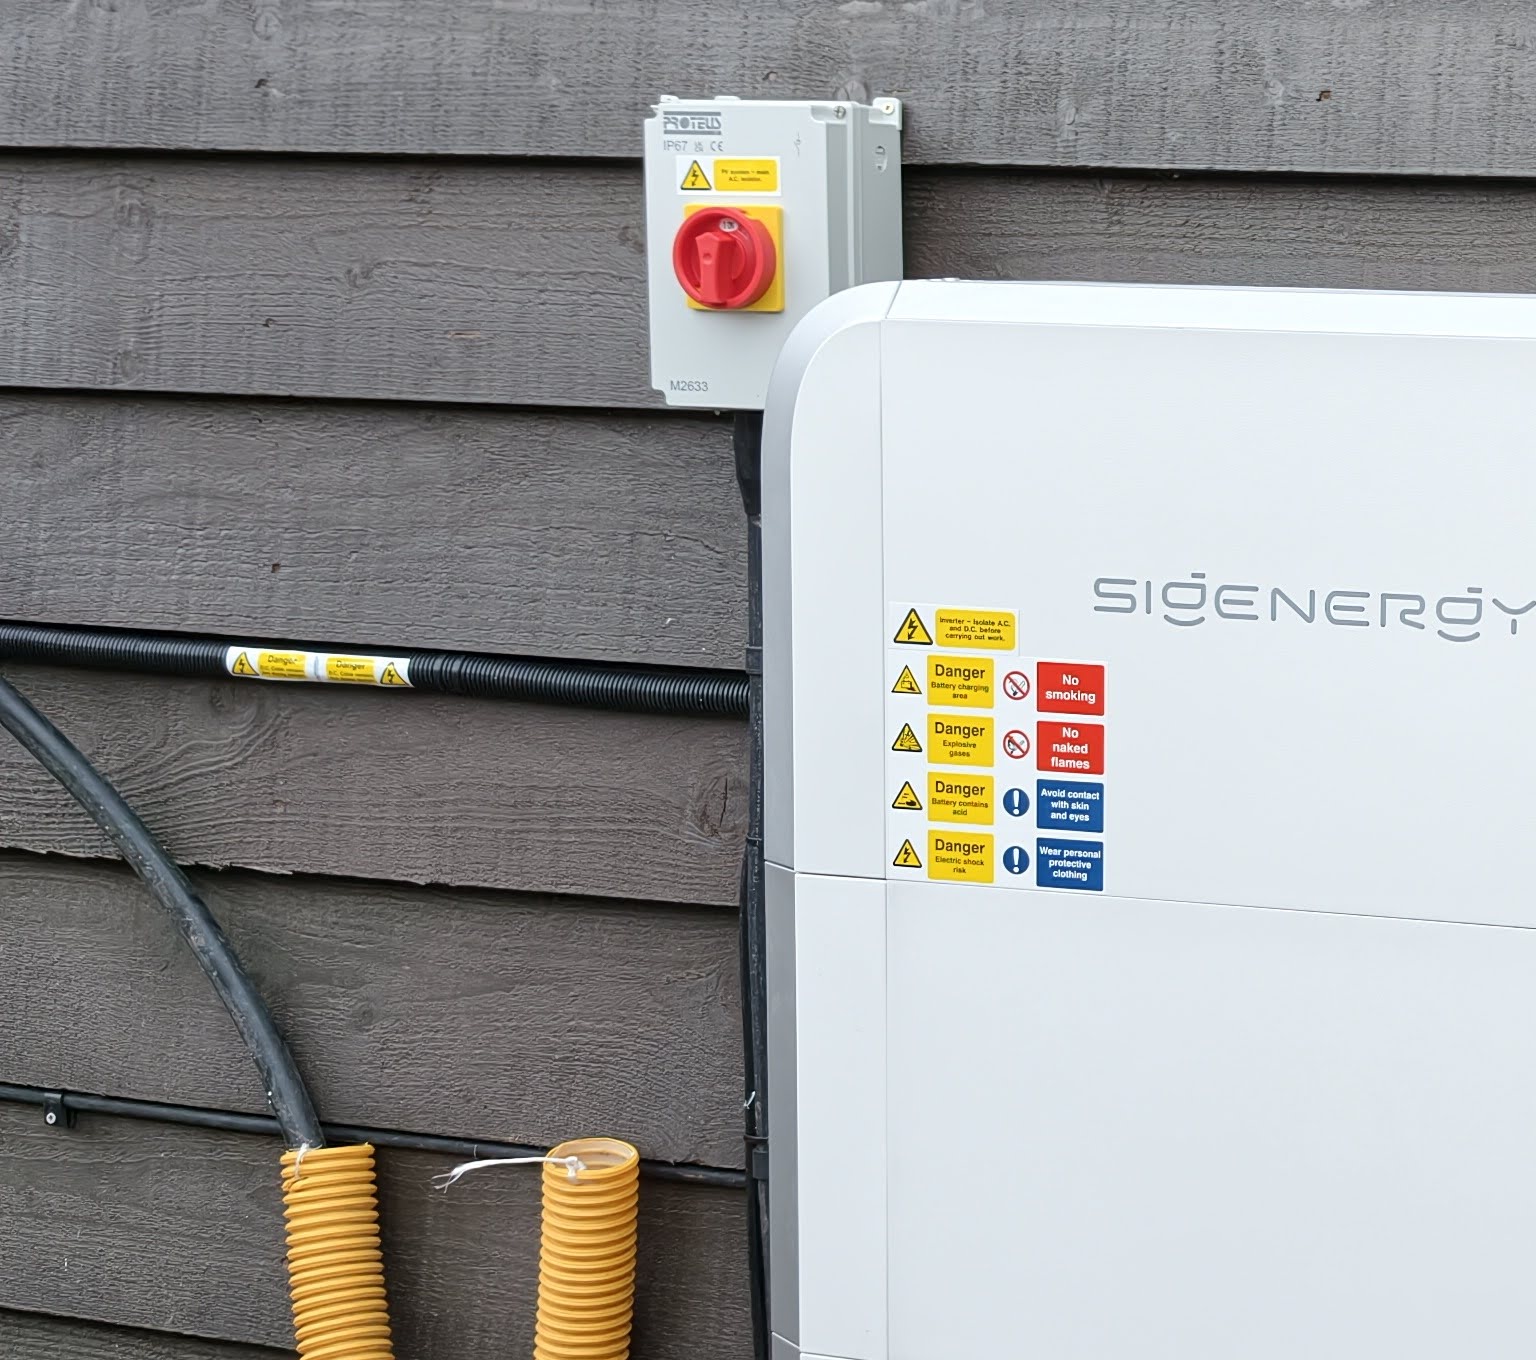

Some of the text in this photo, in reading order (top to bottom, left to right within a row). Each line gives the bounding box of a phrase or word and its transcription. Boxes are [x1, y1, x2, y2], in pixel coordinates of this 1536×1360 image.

[662, 116, 722, 130] PROTEUS
[663, 140, 688, 151] IP67
[670, 380, 709, 391] M2633
[939, 616, 965, 625] Inverter
[945, 633, 972, 641] carrying
[335, 660, 366, 671] Danger
[935, 664, 985, 681] Danger
[1062, 674, 1080, 685] No
[931, 682, 990, 693] Battery charging
[1045, 690, 1096, 704] smoking
[935, 722, 985, 739] Danger
[1062, 727, 1080, 738] No
[942, 740, 977, 749] Explosive
[1052, 743, 1089, 754] naked
[949, 750, 971, 758] gases
[1051, 756, 1090, 770] flames
[935, 780, 985, 798] Danger
[1040, 788, 1100, 800] Avoid contact
[931, 798, 989, 809] Battery contains
[1050, 800, 1089, 810] with skin
[952, 808, 968, 816] acid
[1050, 811, 1090, 822] and eyes
[935, 838, 985, 856] Danger
[1039, 846, 1101, 859] Wear personal
[935, 856, 985, 866] Electric shock
[1048, 859, 1092, 869] protective
[952, 866, 967, 874] risk
[1052, 869, 1088, 881] clothing
